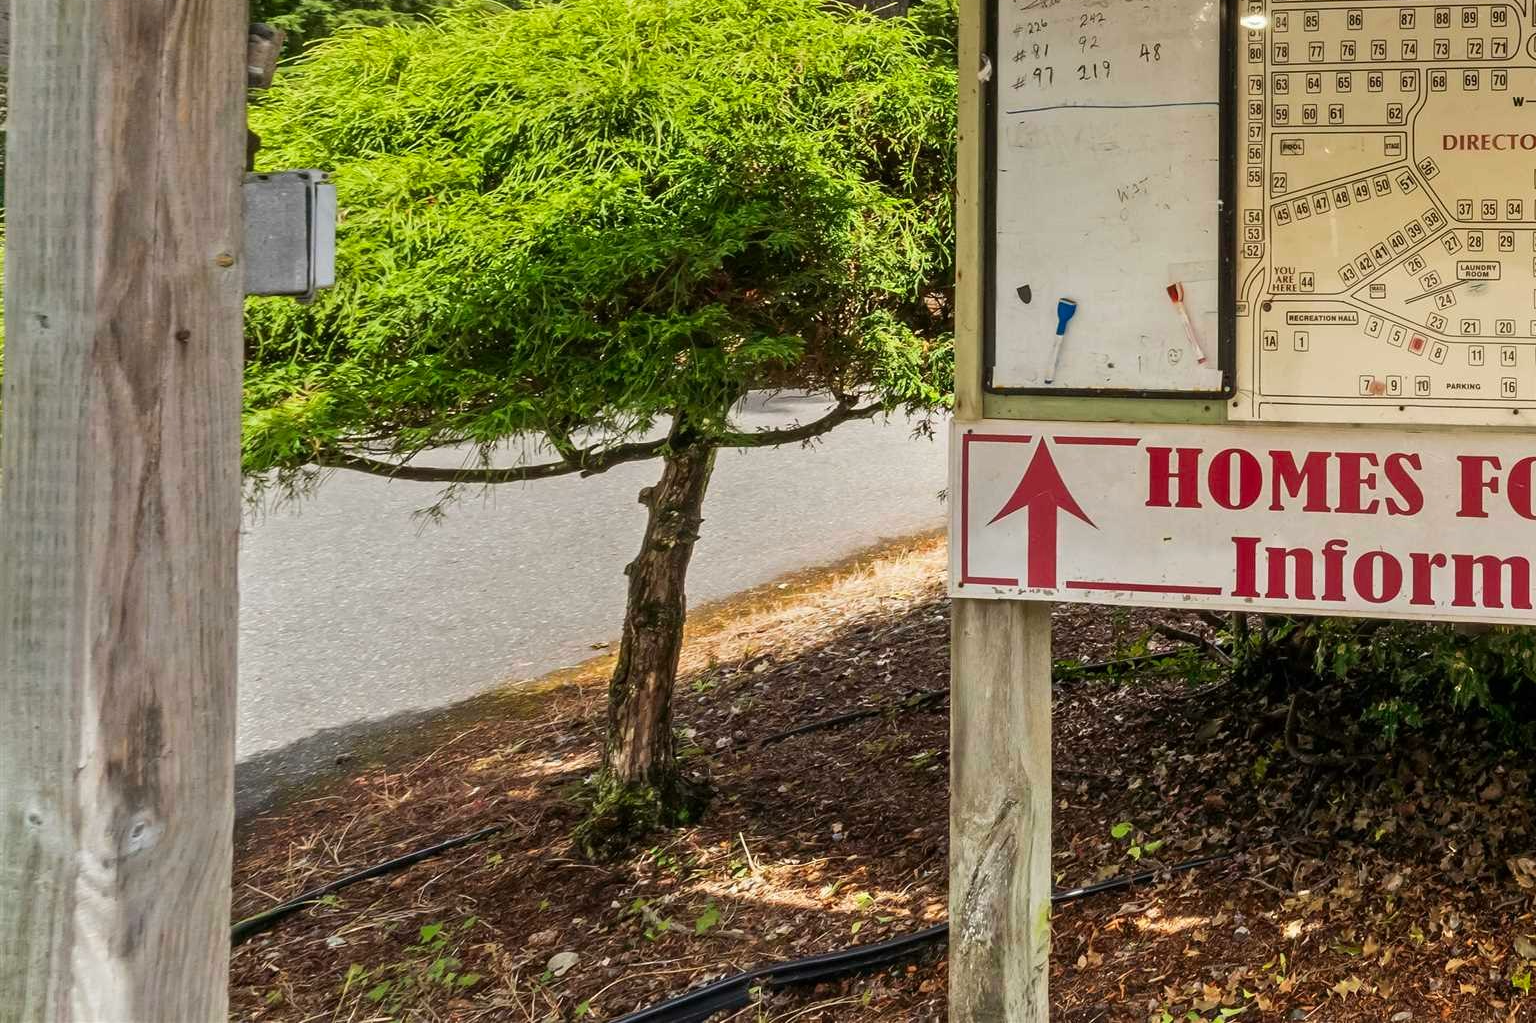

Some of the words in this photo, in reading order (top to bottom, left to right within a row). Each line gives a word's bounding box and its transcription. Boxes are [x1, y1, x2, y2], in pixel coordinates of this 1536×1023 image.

[1306, 16, 1317, 26] 85
[1402, 14, 1413, 25] 87
[1464, 12, 1476, 23] 89
[1493, 11, 1505, 22] 90
[1078, 36, 1099, 54] 92
[1139, 43, 1162, 62] 48
[1250, 48, 1261, 59] 80
[1276, 47, 1287, 57] 78
[1311, 46, 1322, 56] 77
[1373, 44, 1384, 55] 75
[1436, 43, 1448, 54] 73
[1470, 43, 1481, 54] 72
[1494, 42, 1506, 54] 71
[1077, 61, 1111, 81] 219
[1250, 80, 1262, 90] 79
[1276, 79, 1287, 90] 63
[1308, 78, 1319, 88] 64
[1370, 77, 1381, 87] 66
[1433, 76, 1445, 87] 68
[1465, 75, 1477, 86] 69
[1494, 74, 1506, 86] 70
[1513, 97, 1524, 106] W
[1250, 104, 1261, 114] 58
[1276, 109, 1287, 120] 59
[1331, 109, 1342, 119] 61
[1389, 108, 1401, 119] 62
[1250, 127, 1261, 137] 57
[1421, 161, 1435, 175] 36
[1249, 171, 1260, 182] 55
[1274, 177, 1285, 188] 22
[1376, 179, 1388, 191] 50
[1400, 176, 1414, 190] 51
[1356, 186, 1368, 197] 49
[1316, 197, 1328, 209] 47
[1277, 209, 1289, 220] 45
[1459, 204, 1471, 215] 37
[1484, 204, 1495, 215] 35
[1508, 203, 1520, 215] 34
[1425, 213, 1438, 226] 38
[1392, 235, 1404, 248] 40
[1444, 237, 1458, 250] 27
[1500, 236, 1512, 247] 29
[1247, 246, 1259, 256] 52
[1375, 246, 1388, 259] 41
[1409, 259, 1421, 270] 26
[1342, 270, 1355, 281] 43
[1302, 278, 1313, 286] 44
[1425, 276, 1438, 287] 25
[1273, 284, 1297, 292] HERE
[1440, 294, 1452, 307] 24
[1370, 321, 1378, 332] 3
[1431, 316, 1443, 328] 23
[1464, 322, 1476, 332] 21
[1500, 322, 1512, 332] 20
[1264, 337, 1276, 346] 1A
[1393, 331, 1400, 341] 5
[1435, 348, 1441, 358] 8
[1471, 351, 1482, 360] 11
[1392, 380, 1397, 390] 9
[1503, 382, 1515, 392] 16
[1145, 447, 1425, 516] HOMES
